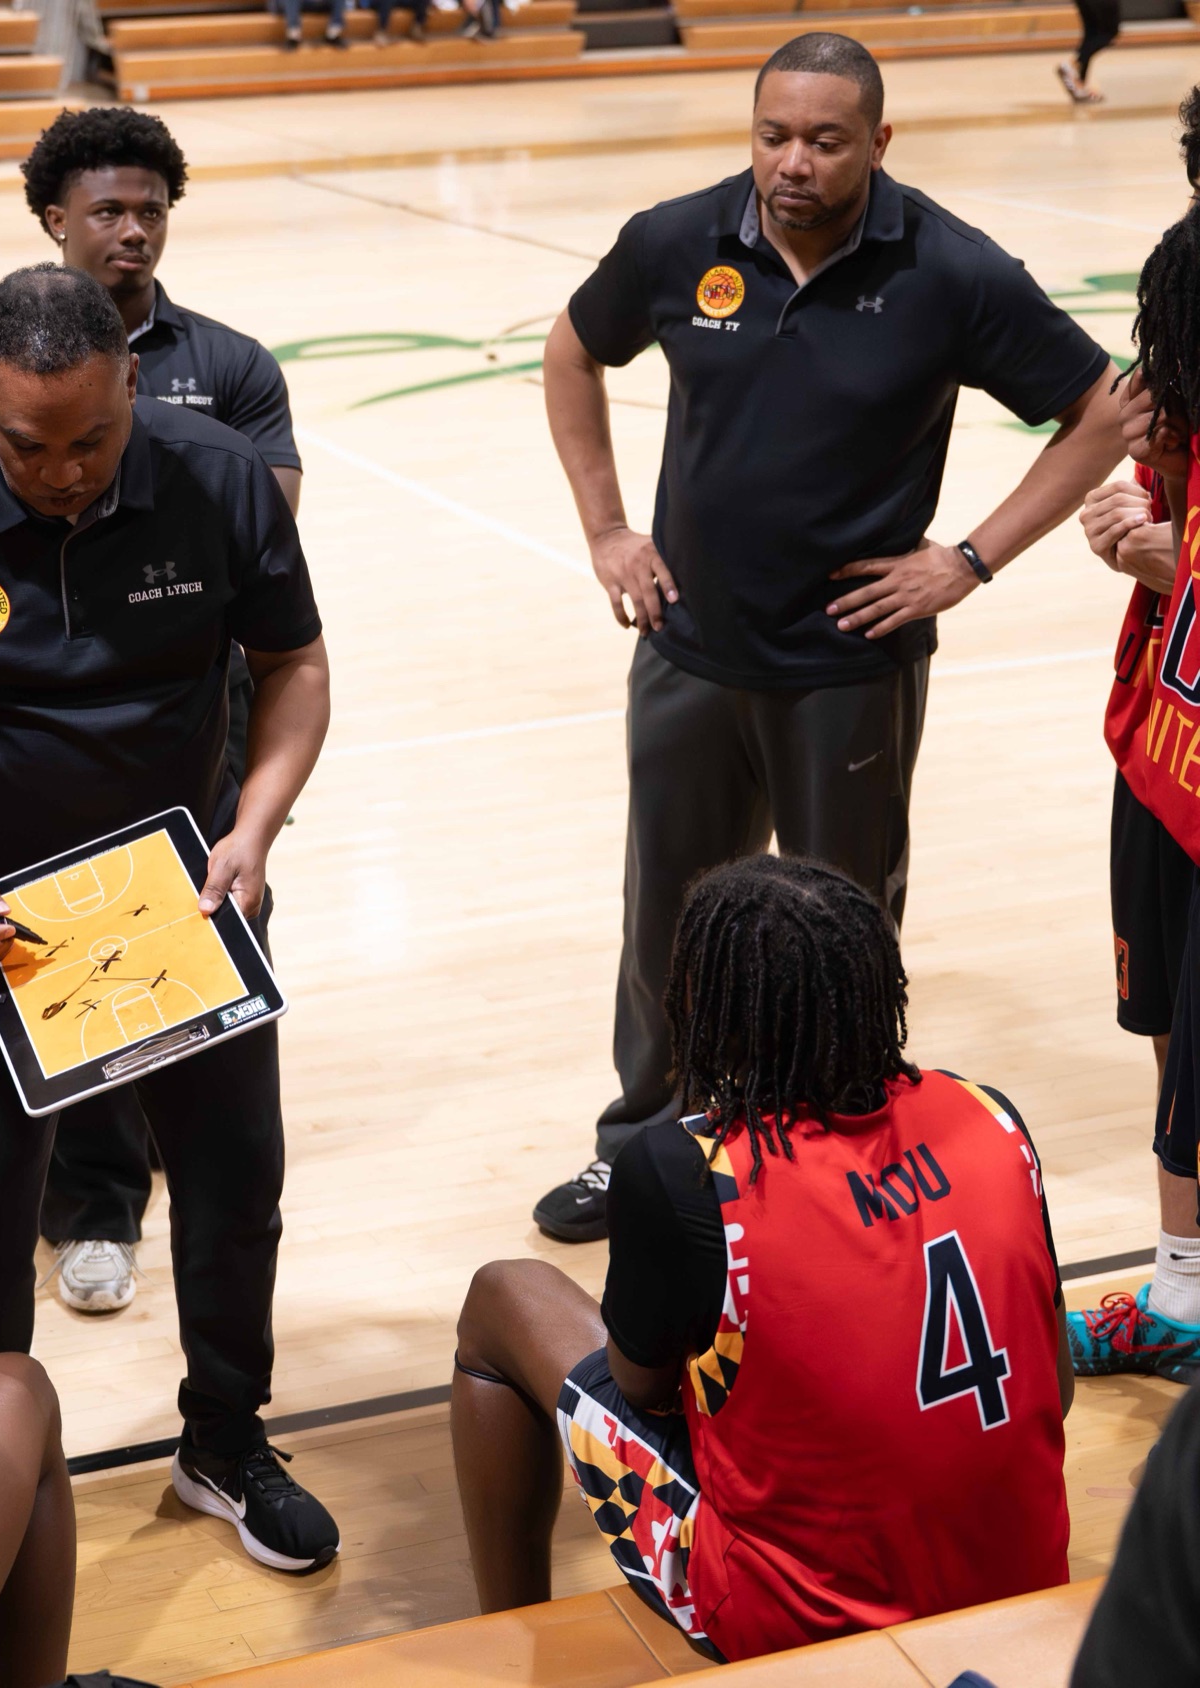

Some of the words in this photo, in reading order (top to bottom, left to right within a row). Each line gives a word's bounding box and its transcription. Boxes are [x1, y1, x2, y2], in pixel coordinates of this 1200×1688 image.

[692, 316, 722, 329] COACH
[725, 321, 740, 331] TY
[128, 588, 163, 604] COACH
[166, 581, 203, 596] LYNCH
[1145, 697, 1200, 798] NITE
[1114, 929, 1129, 1000] 3
[846, 1142, 952, 1228] MDU
[915, 1229, 1012, 1432] 4
